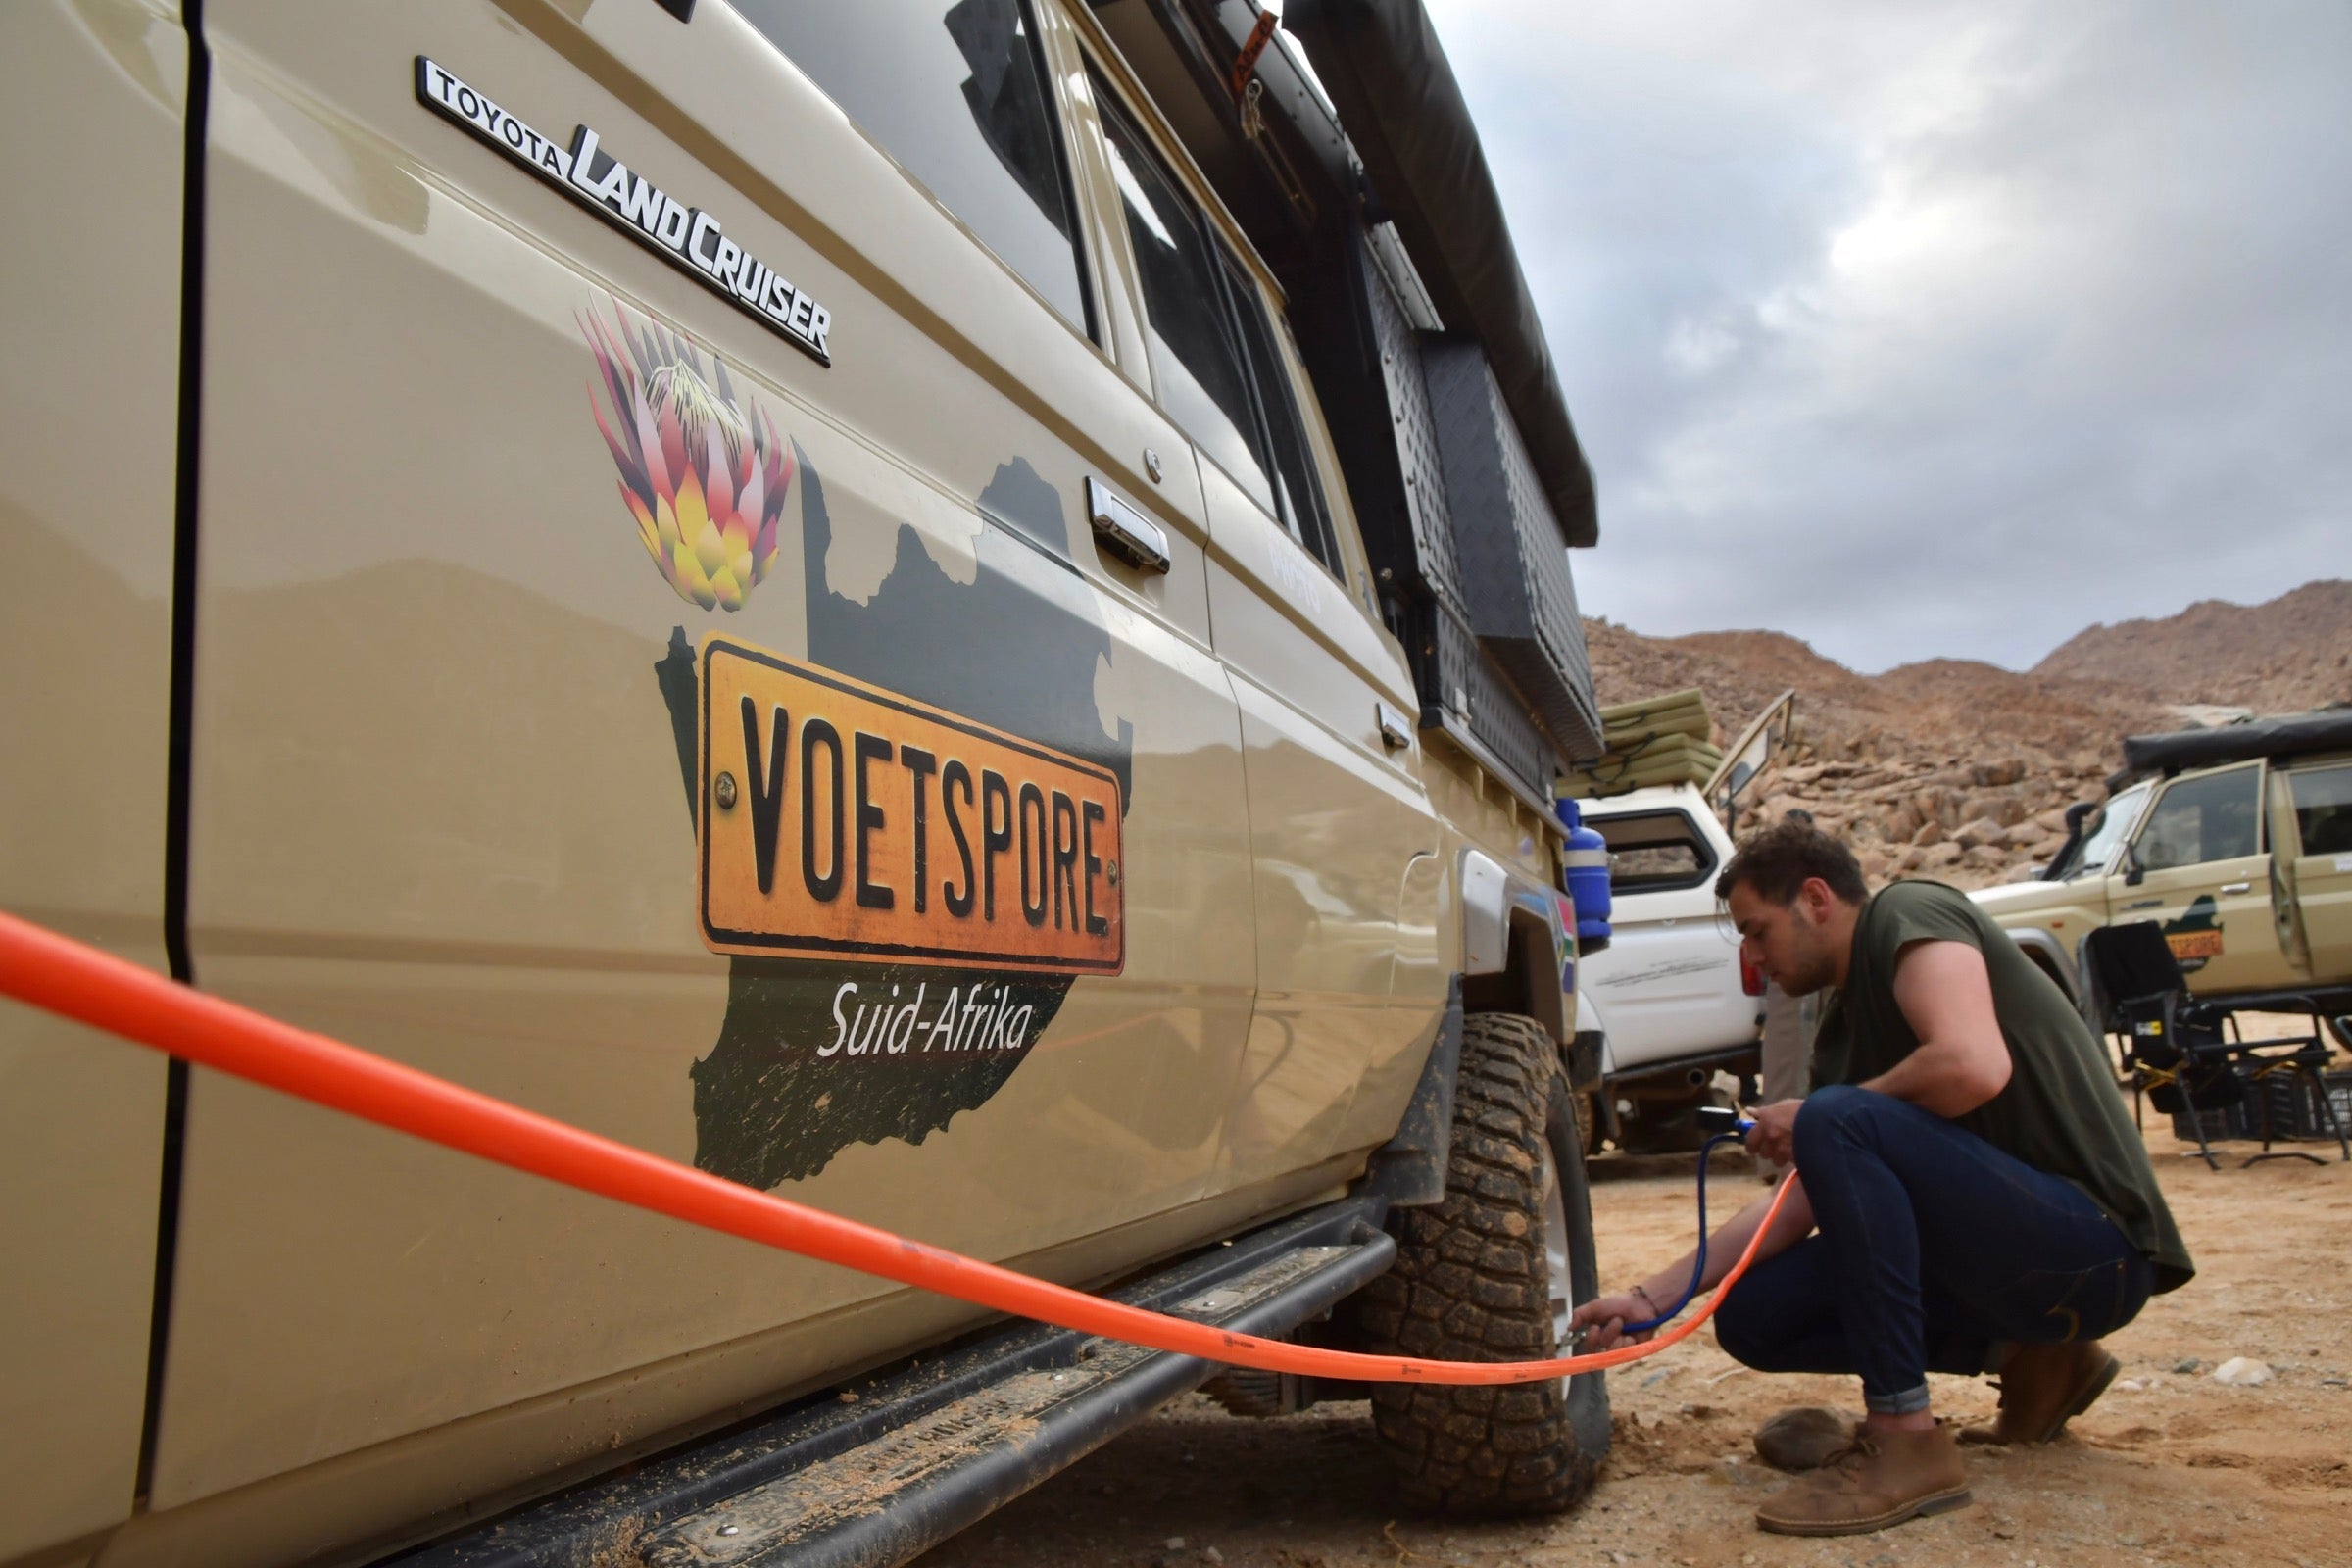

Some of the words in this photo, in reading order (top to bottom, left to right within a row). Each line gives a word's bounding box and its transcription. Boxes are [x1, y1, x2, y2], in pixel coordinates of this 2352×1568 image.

[435, 68, 563, 177] TOYOTA
[741, 695, 1109, 936] VOETSPORE
[816, 982, 1034, 1057] Suid-Afrika
